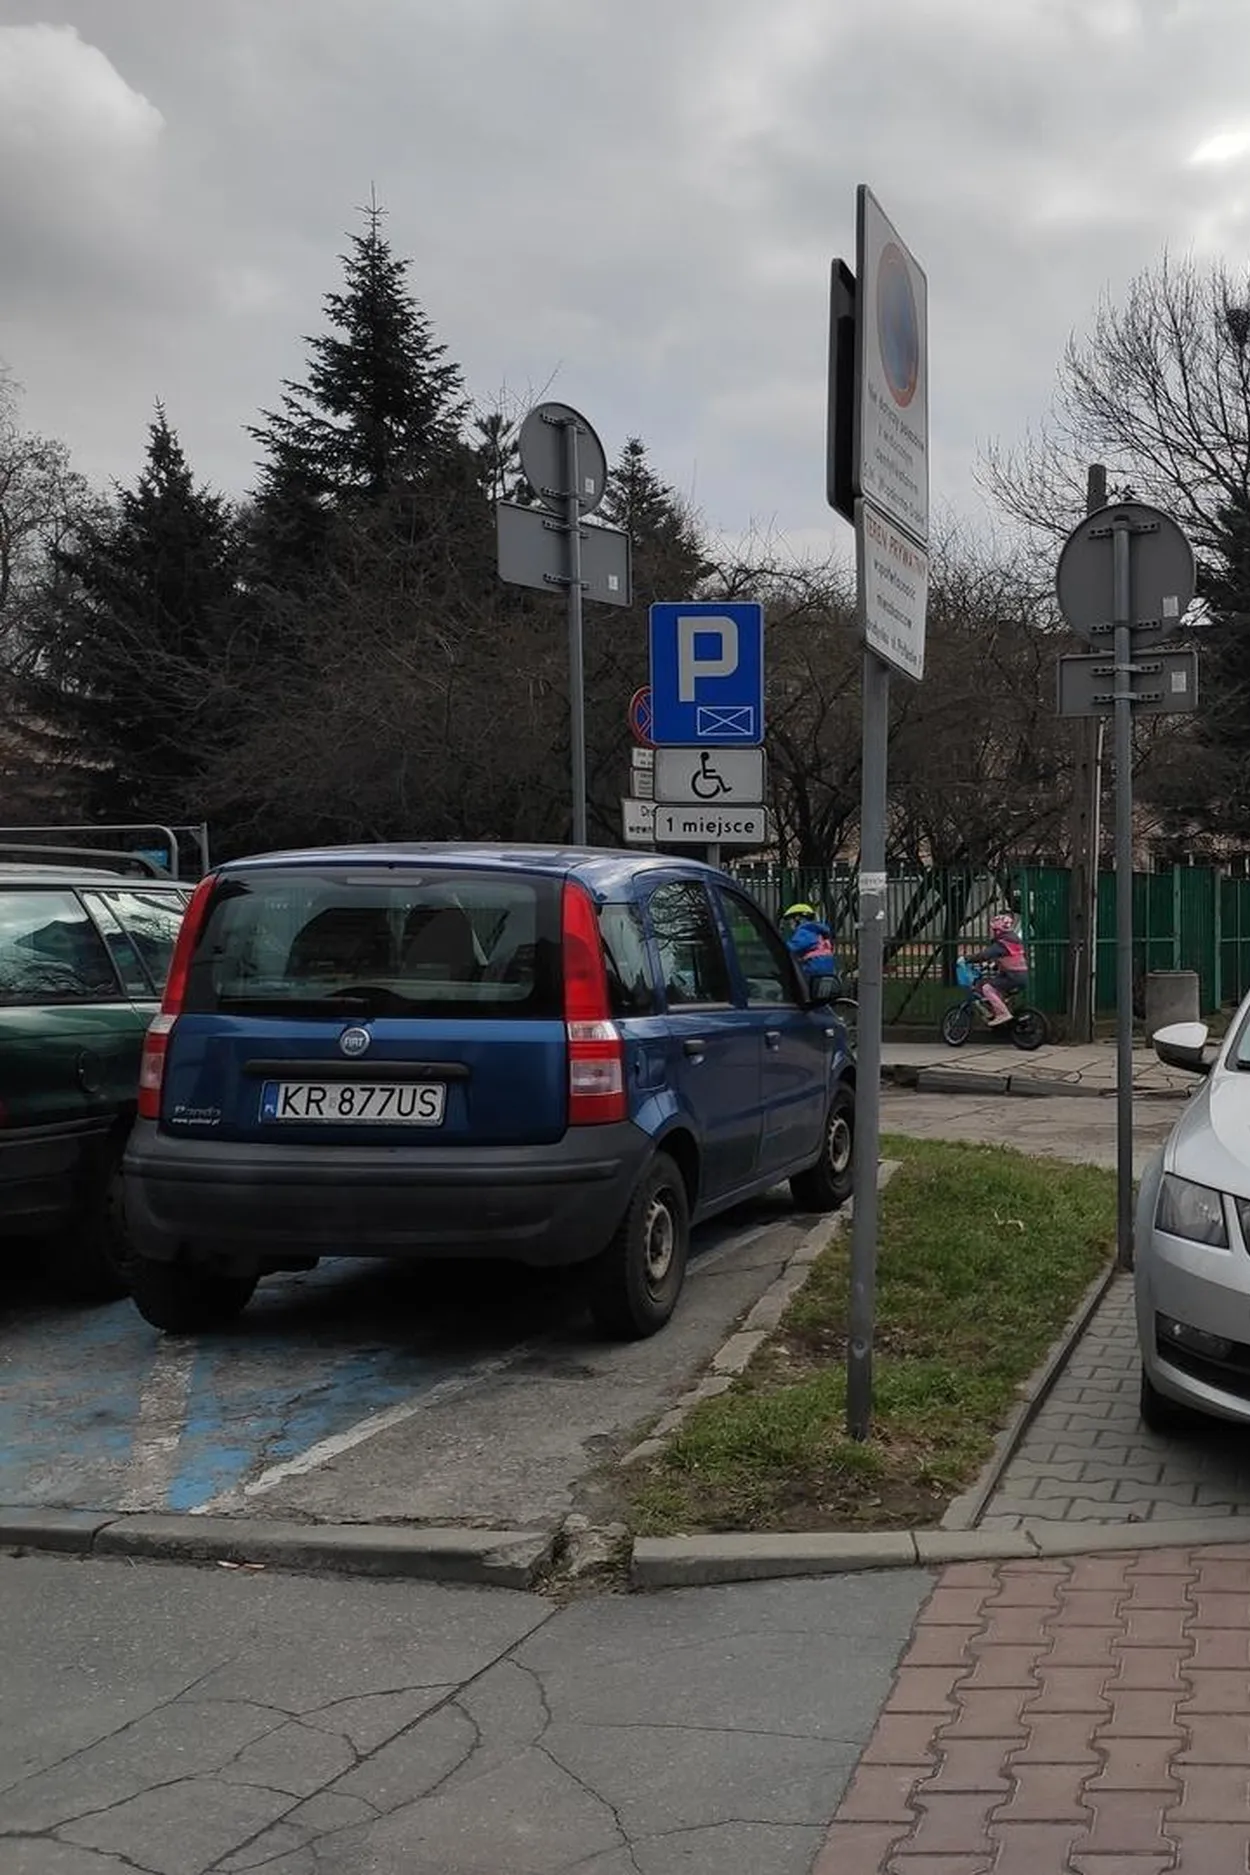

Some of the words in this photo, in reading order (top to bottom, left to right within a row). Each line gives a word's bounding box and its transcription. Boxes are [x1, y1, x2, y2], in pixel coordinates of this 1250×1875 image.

[677, 616, 738, 702] P
[666, 817, 674, 832] 1
[682, 816, 755, 837] miejsce
[281, 1086, 327, 1116] KR
[338, 1088, 437, 1117] 877US
